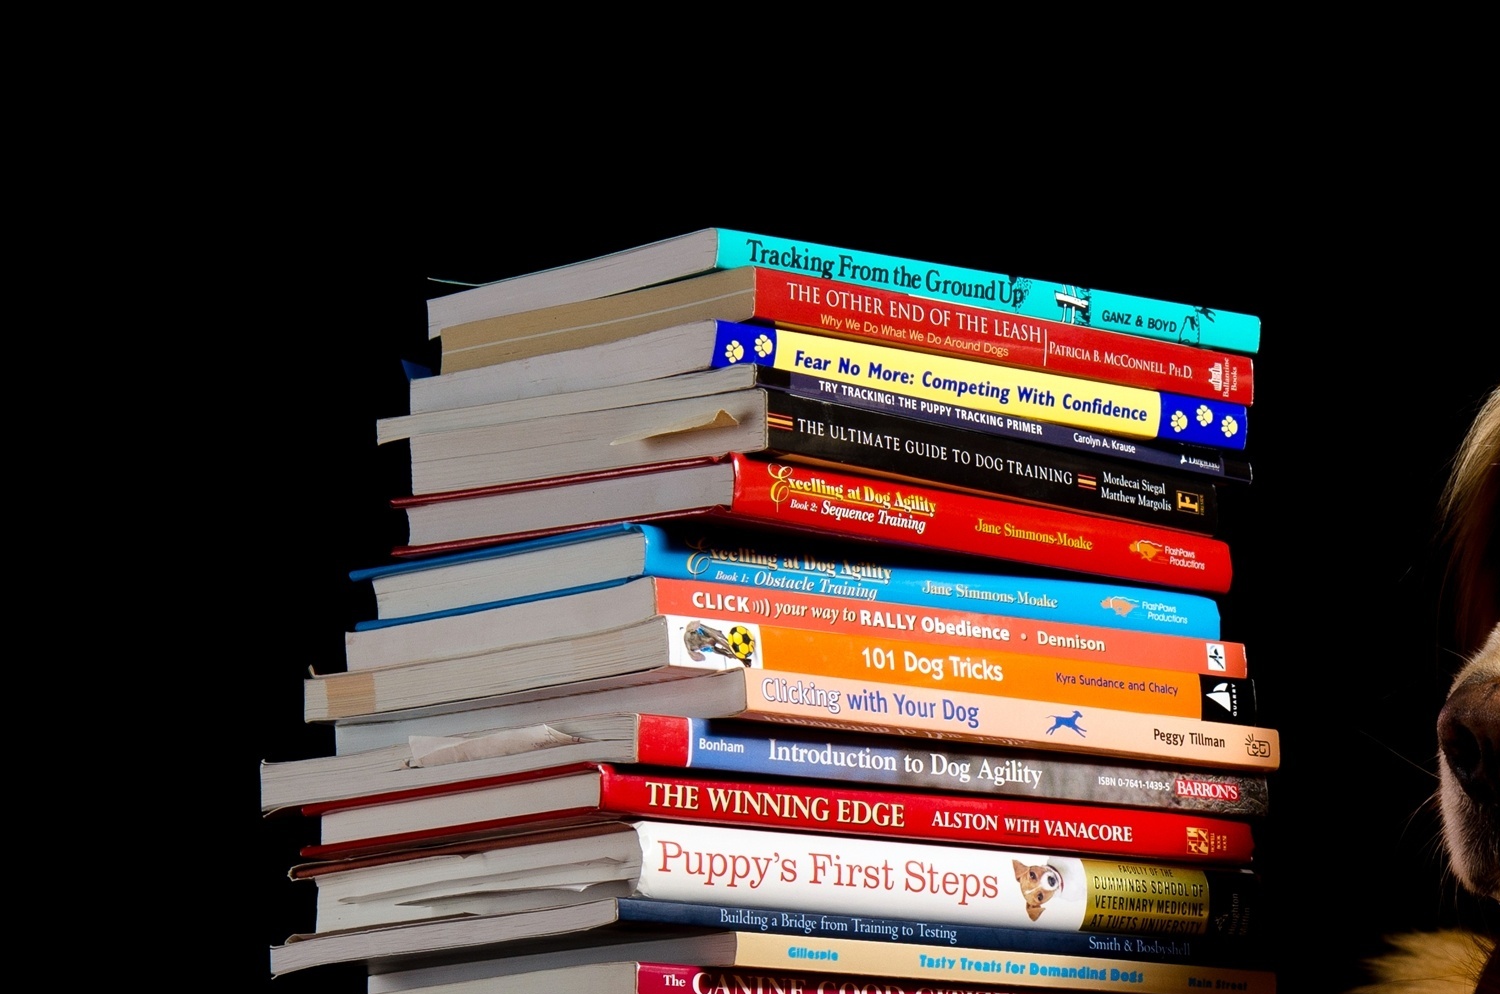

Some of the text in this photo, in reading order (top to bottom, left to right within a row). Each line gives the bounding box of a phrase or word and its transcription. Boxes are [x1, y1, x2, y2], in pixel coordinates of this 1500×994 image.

[746, 239, 1024, 307] Tracking From the Ground Up
[787, 282, 1042, 344] THE OTHER END OF THE LEASH
[1102, 310, 1177, 333] GANZ & BOYD
[795, 350, 1147, 422] Fear No More: Competing With Confidence
[819, 380, 1043, 435] TRY TRACKING! THE PUPPY TRACKING PRIMER
[797, 418, 1073, 485] THE ULTIMATE GUIDE TO DOG TRAINING
[1073, 432, 1136, 454] Carolyn A. Krause
[767, 463, 936, 517] Excelling at Dog Agility
[790, 499, 926, 534] Book 2: Sequence Training
[975, 518, 1093, 551] Jane Simmons-Moake
[692, 591, 1106, 651] CLICK your way to RALLY Obedience Dennison
[862, 647, 1004, 682] 101 Dog Tricks
[1056, 672, 1178, 696] Kyra Sundance and Chalcy
[761, 678, 979, 728] Clicking with Your Dog
[699, 738, 744, 753] Bonham
[1154, 729, 1225, 748] Peggy Tillman
[769, 739, 1042, 789] Introduction to Dog Agility
[1098, 776, 1170, 792] ISBN 0-7641-1439-5
[1177, 780, 1238, 799] BARRON'S
[645, 782, 904, 827] THE WINNING EDGE
[932, 811, 1132, 843] ALSTON WITH VANACORE
[657, 840, 998, 905] Puppy's First Steps
[720, 909, 957, 945] Building a Bridge from Training to Testing
[788, 946, 838, 961] Gillespie
[919, 954, 1144, 983] Tasty Treats for Demanding Dogs
[663, 974, 686, 988] The
